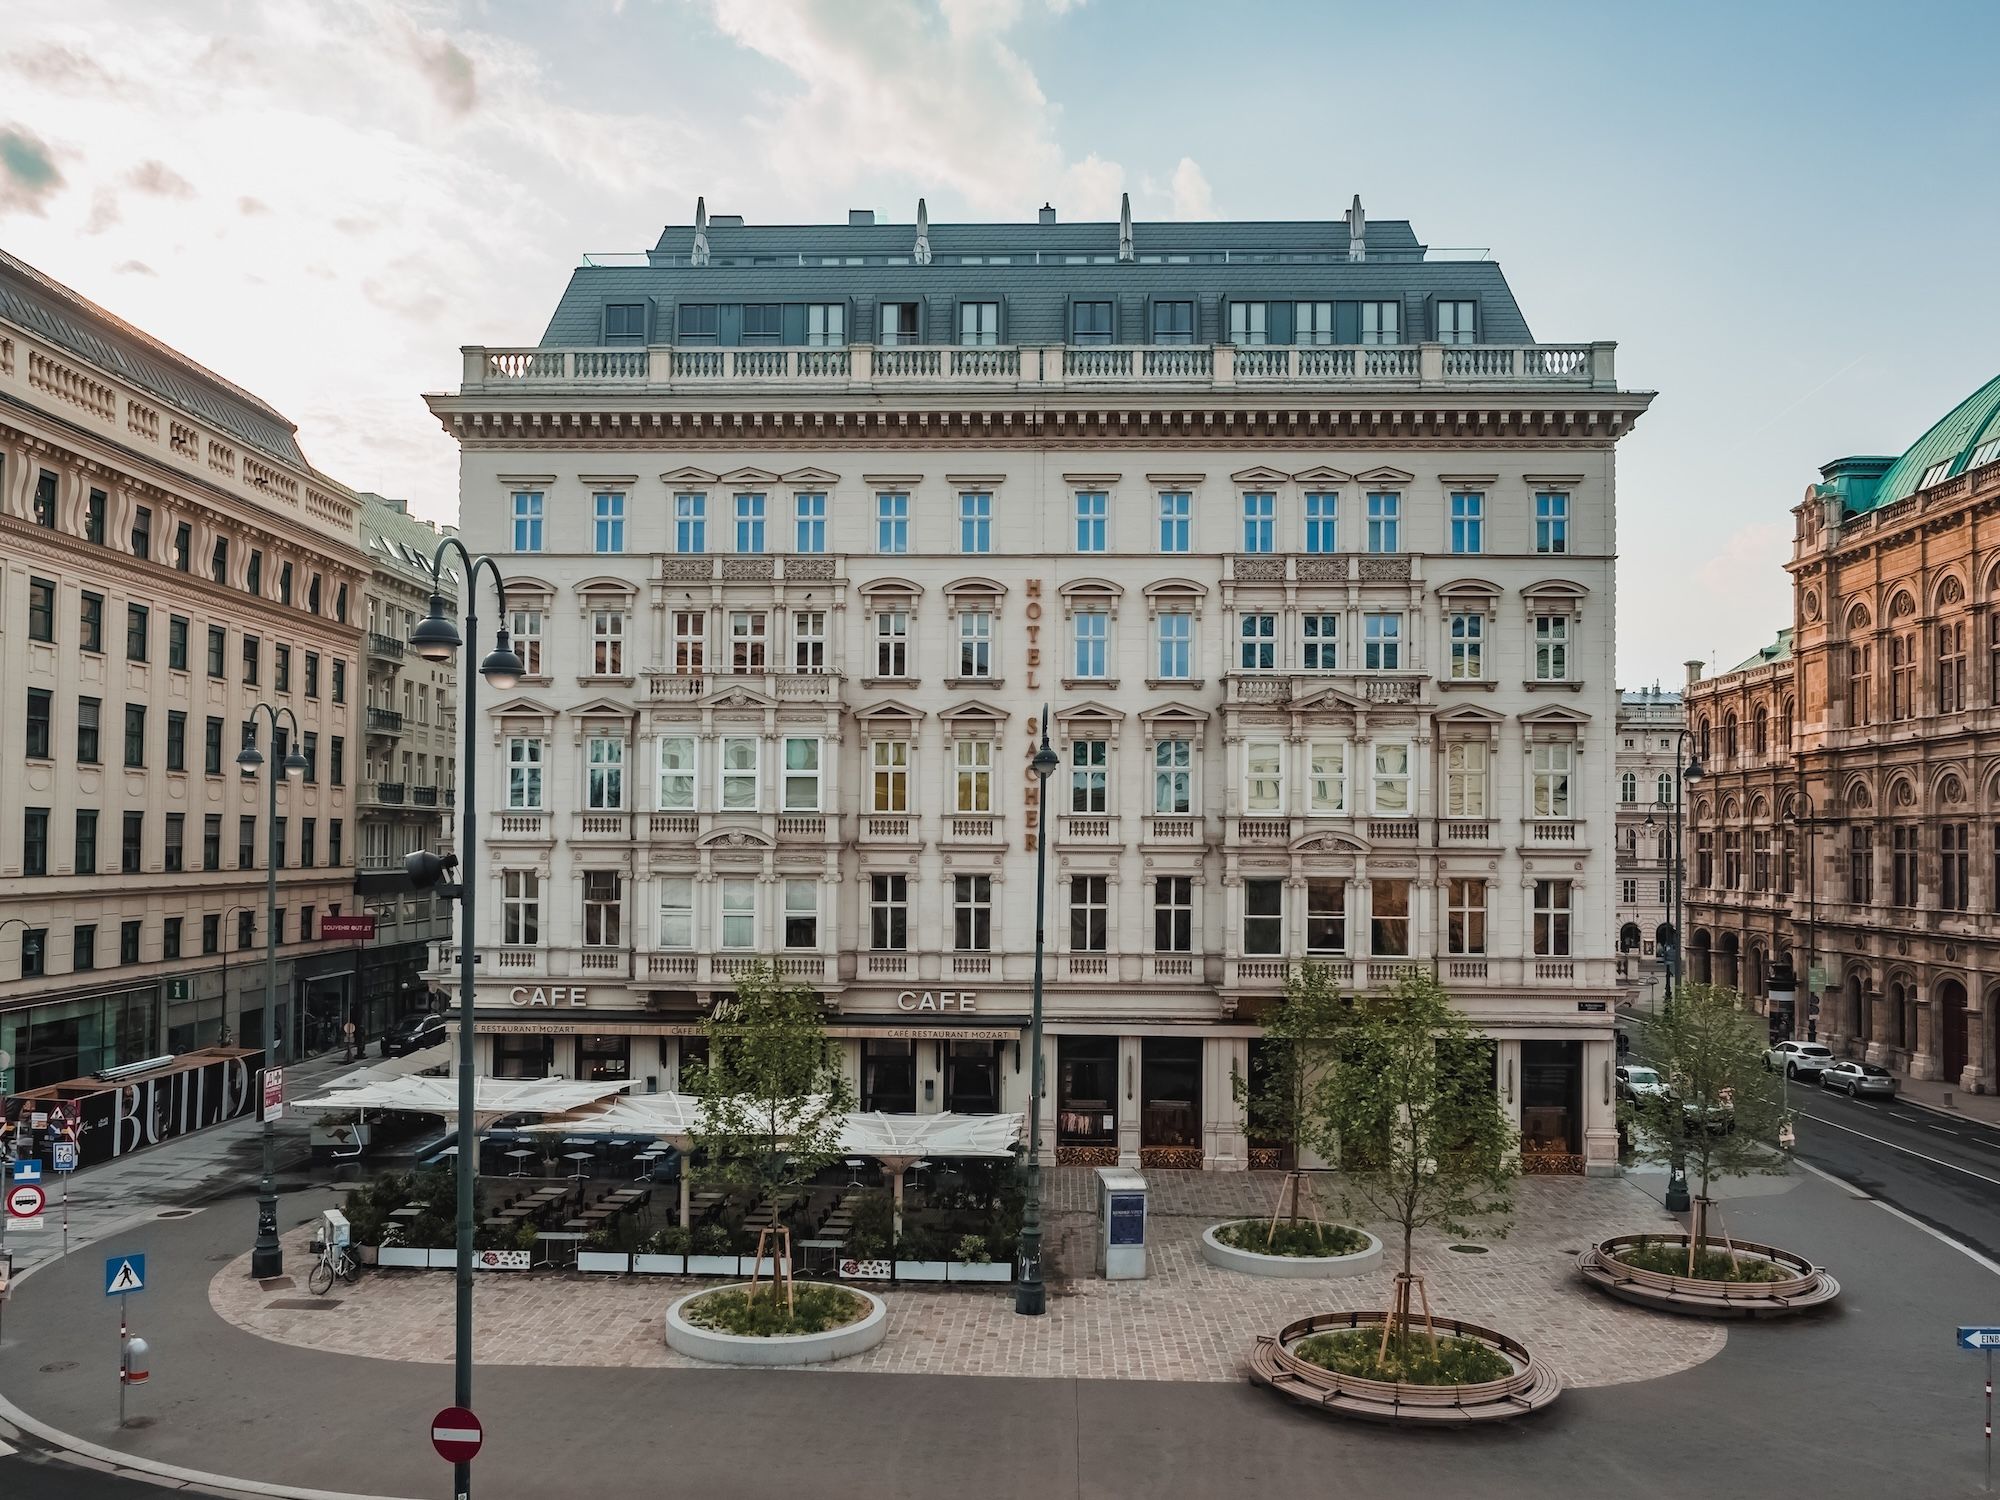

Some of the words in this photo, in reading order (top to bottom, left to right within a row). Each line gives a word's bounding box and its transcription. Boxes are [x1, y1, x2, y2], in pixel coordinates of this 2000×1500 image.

[1026, 579, 1041, 690] HOTEL
[1024, 717, 1040, 852] SACHER
[509, 986, 587, 1007] CAFE
[897, 991, 977, 1012] CAFE
[912, 1030, 969, 1038] RESTAURANT
[971, 1031, 1008, 1039] MOZART
[113, 1056, 248, 1158] BUILD
[1981, 1335, 2000, 1344] EINB
